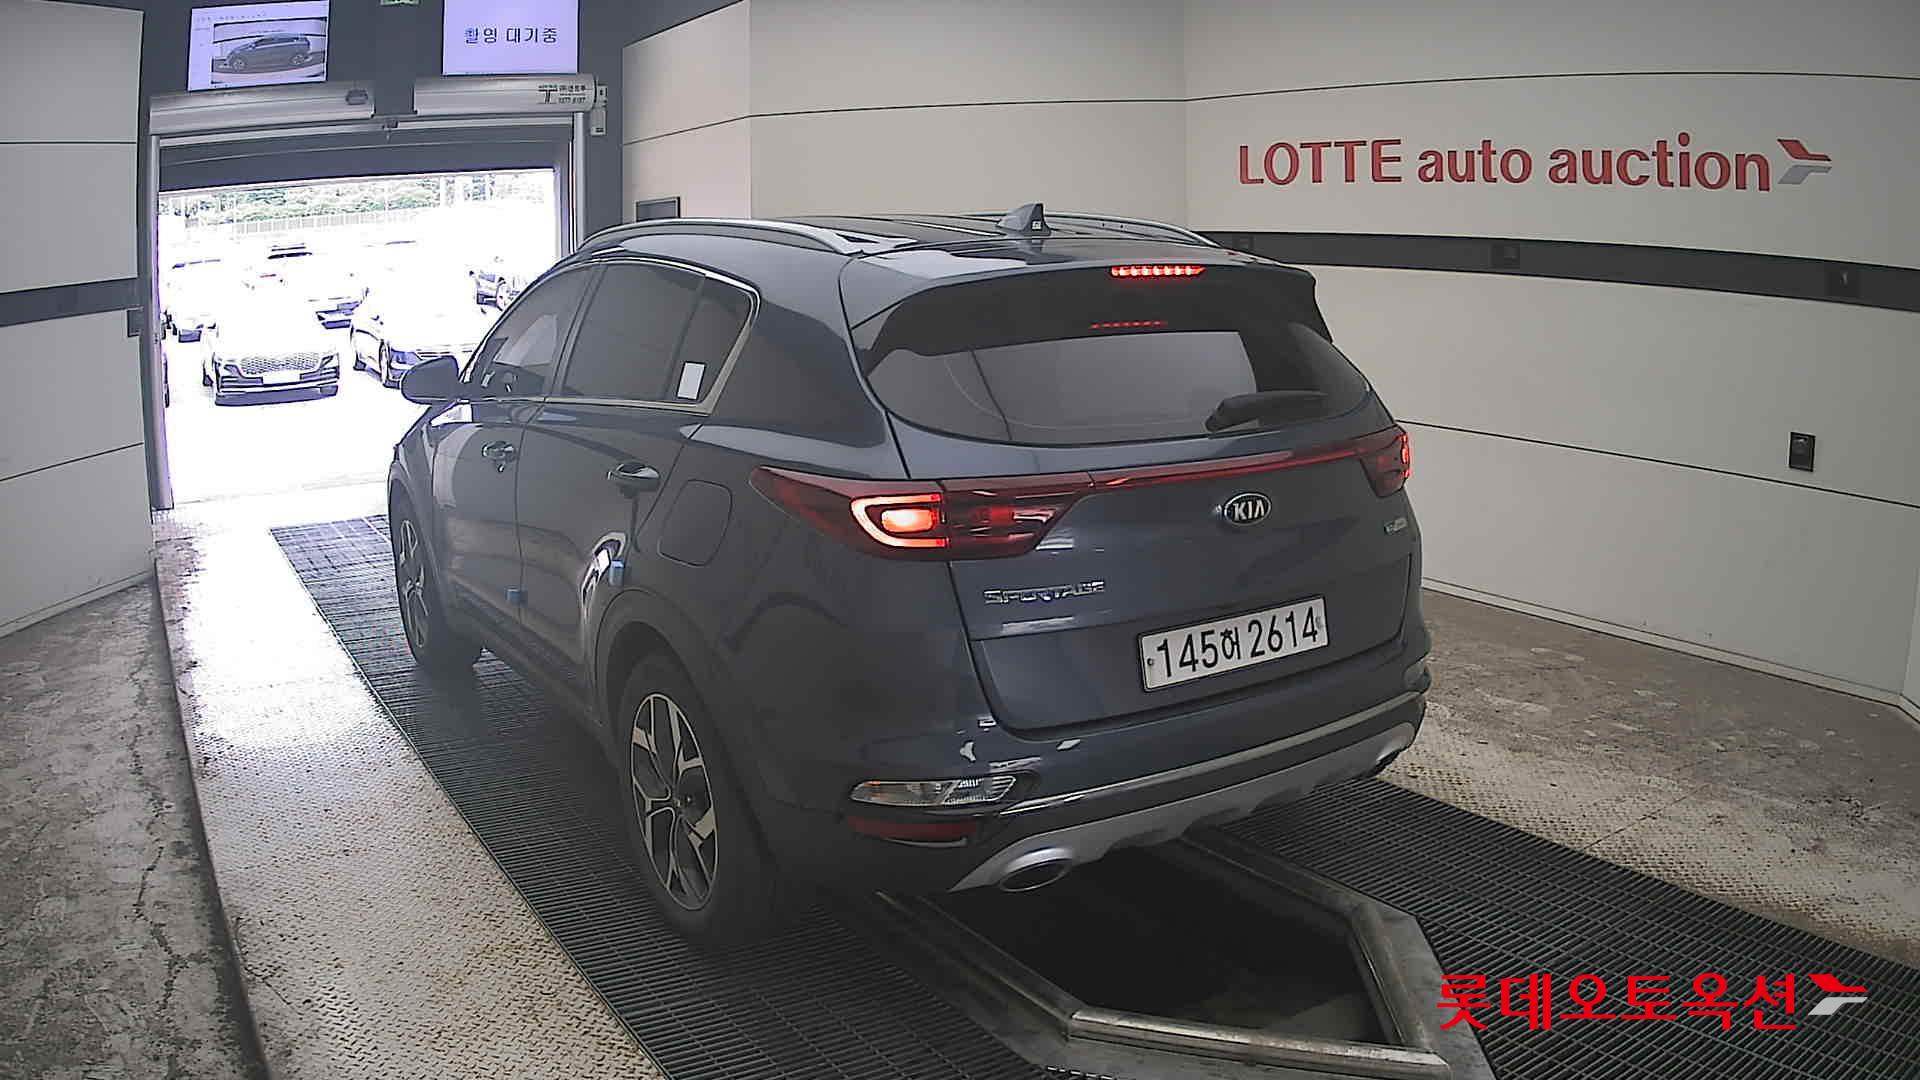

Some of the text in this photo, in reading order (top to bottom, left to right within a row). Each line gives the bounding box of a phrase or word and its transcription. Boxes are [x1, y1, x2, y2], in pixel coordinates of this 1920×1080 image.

[506, 27, 557, 44] 대기중
[1239, 131, 1770, 191] LOTTE auto auction
[1232, 499, 1265, 521] KIA
